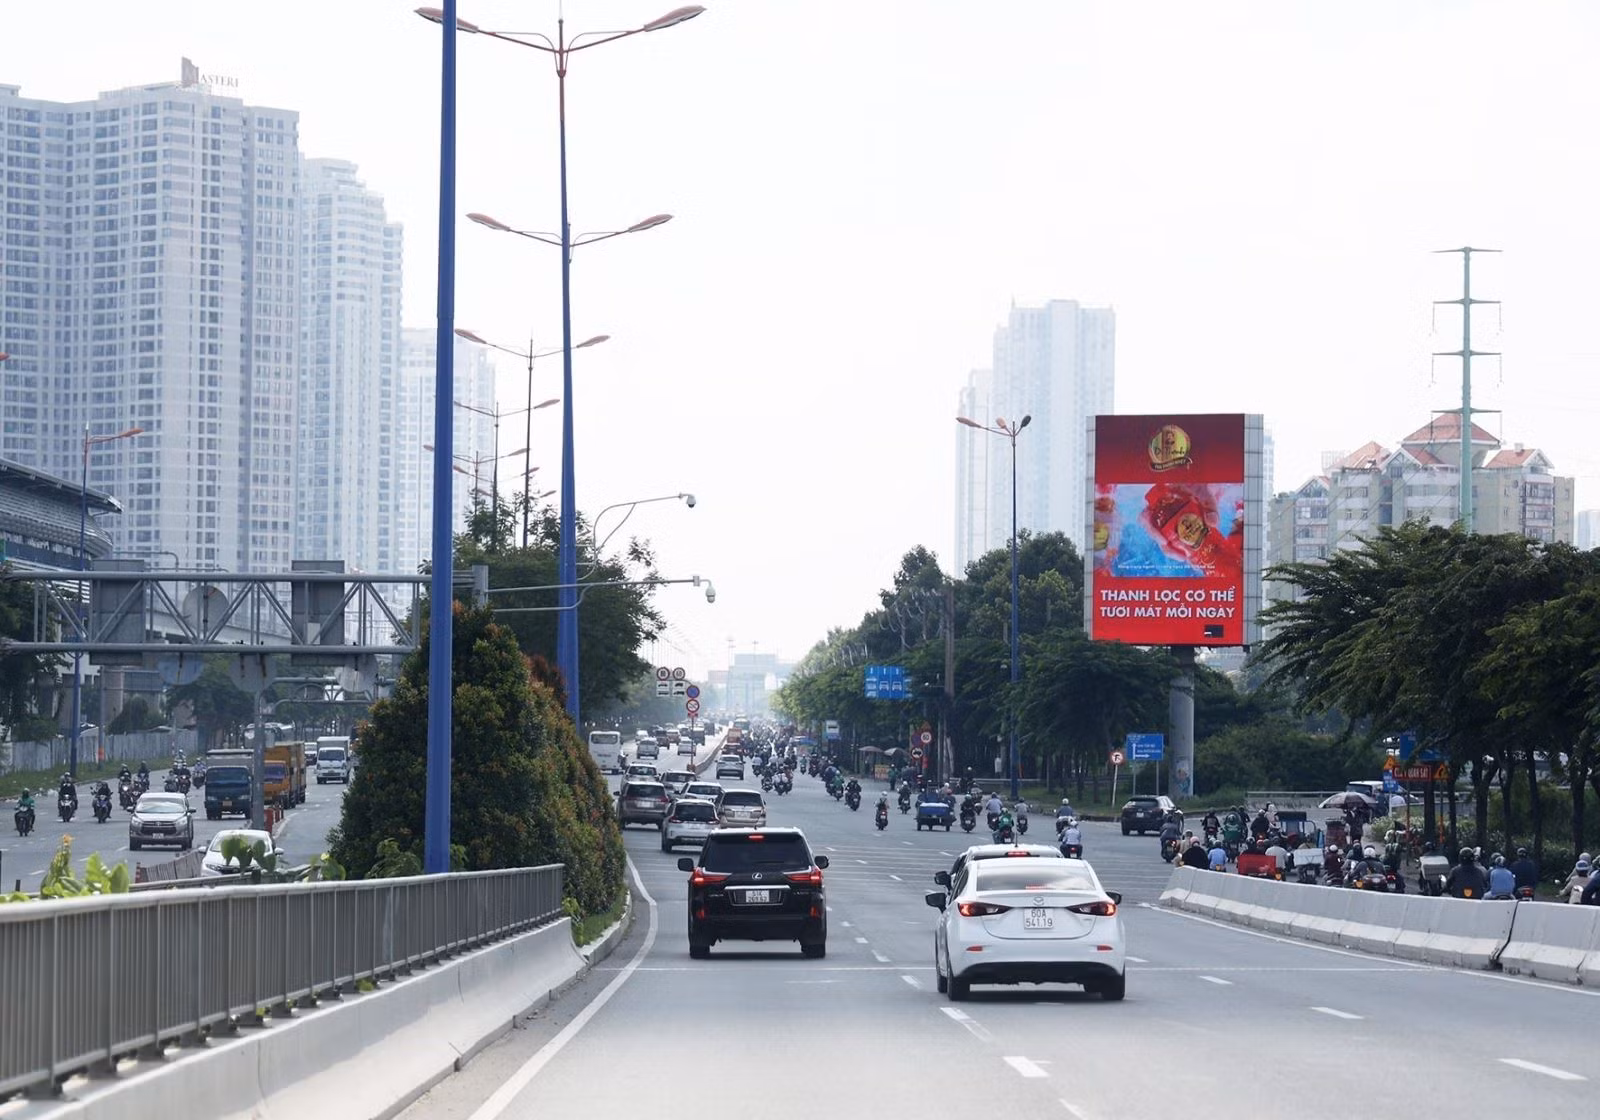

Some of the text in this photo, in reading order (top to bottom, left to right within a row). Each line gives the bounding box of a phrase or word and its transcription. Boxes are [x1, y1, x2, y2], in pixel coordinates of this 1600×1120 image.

[1100, 585, 1236, 604] THANH LỌC CƠ THỂ
[1100, 602, 1235, 618] TƯƠI MÁT MỖI NGÀY
[1031, 909, 1046, 918] 60A
[1026, 918, 1053, 927] 541.19
